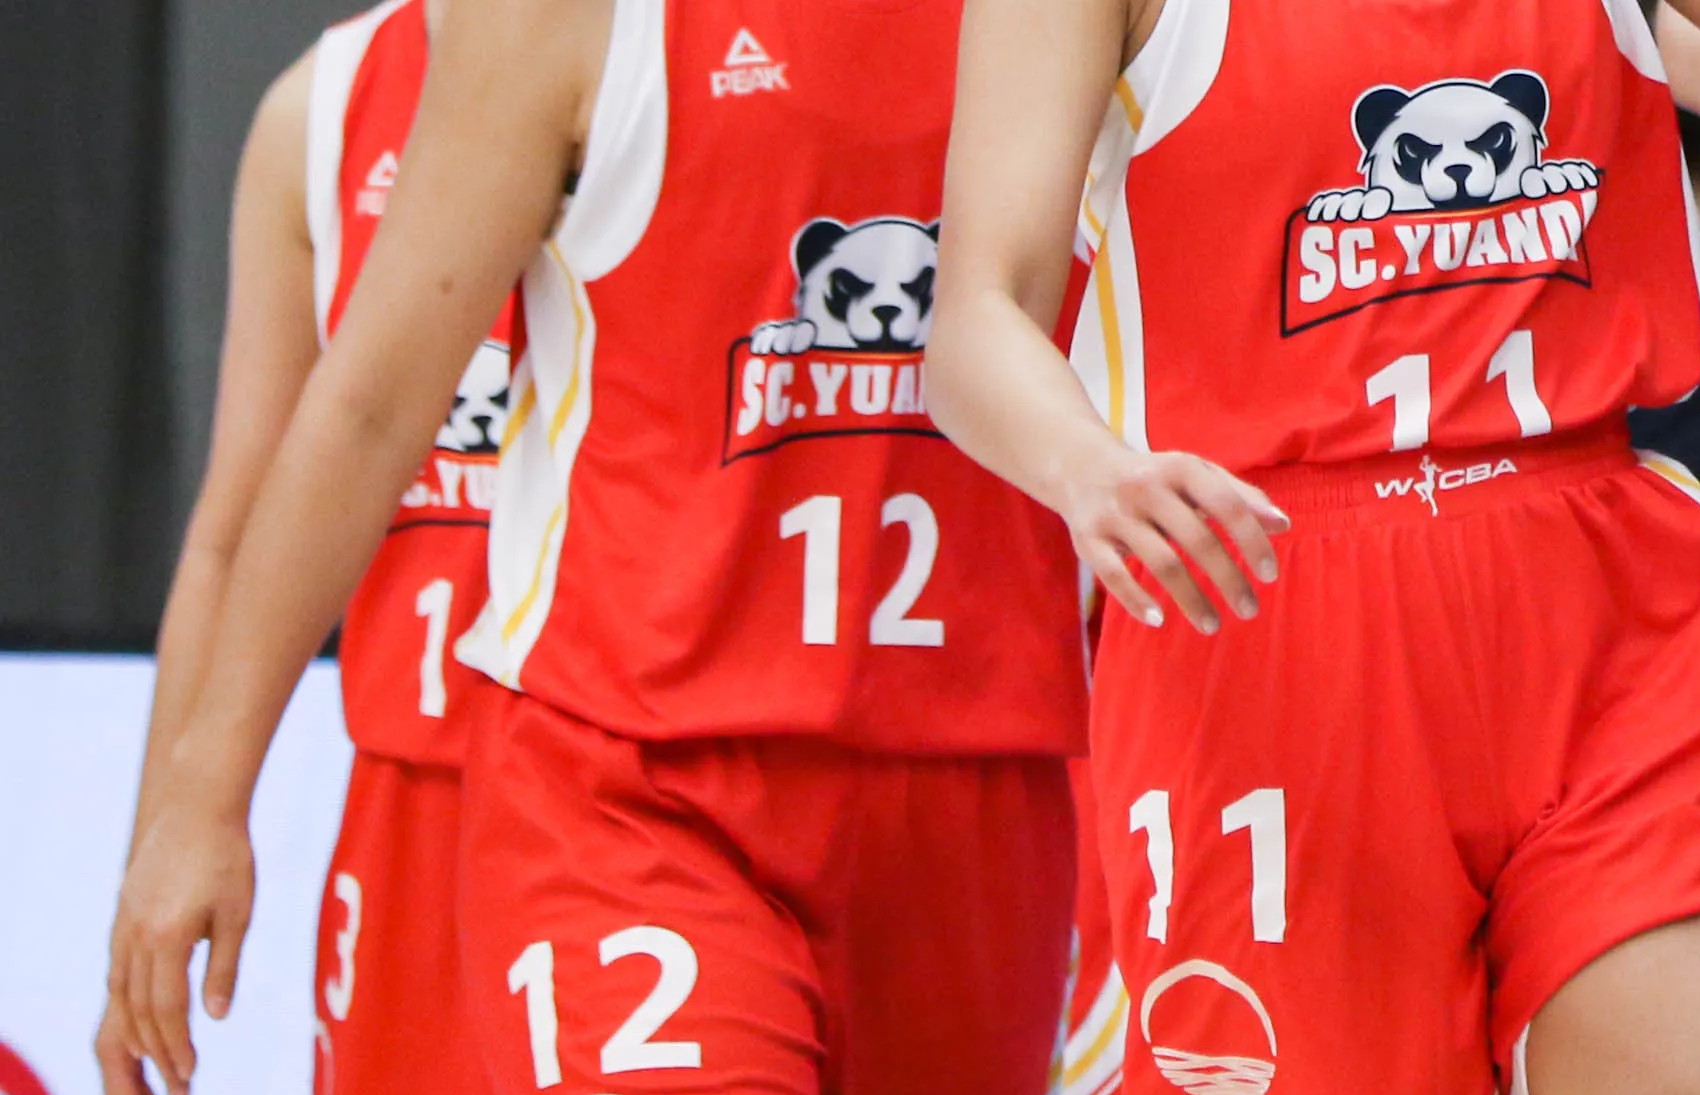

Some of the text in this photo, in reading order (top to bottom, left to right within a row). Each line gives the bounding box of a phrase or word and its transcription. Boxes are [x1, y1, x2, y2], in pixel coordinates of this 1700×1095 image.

[711, 65, 789, 98] PEAK
[737, 357, 928, 436] SC.YUA
[1366, 329, 1551, 451] 11
[779, 493, 945, 646] 12
[1130, 788, 1287, 944] 11
[325, 873, 362, 1021] 3
[508, 925, 701, 1089] 12
